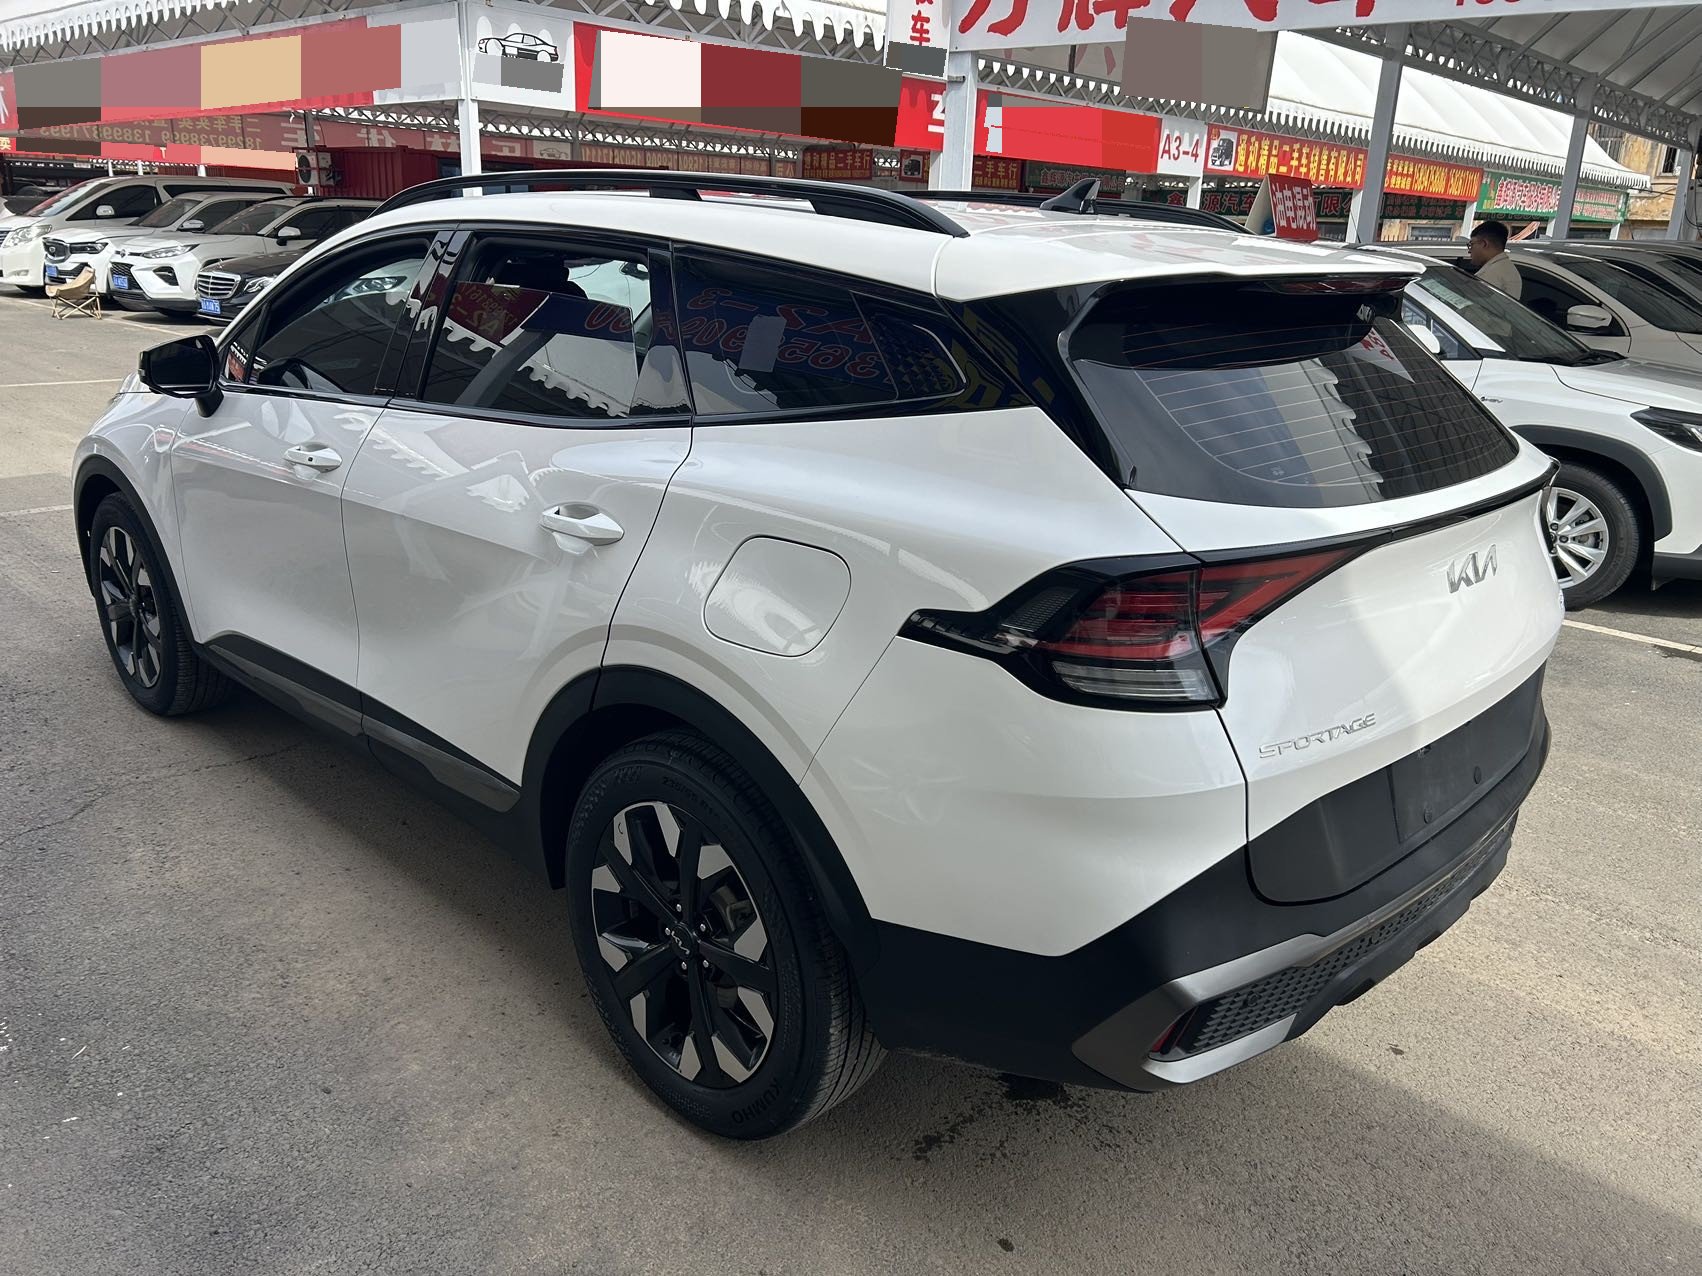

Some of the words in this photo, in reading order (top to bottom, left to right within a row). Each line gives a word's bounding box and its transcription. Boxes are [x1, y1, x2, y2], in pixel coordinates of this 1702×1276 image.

[974, 160, 1018, 179] 二手车行
[1160, 133, 1200, 163] A3-4
[1235, 133, 1365, 187] 通和精品二手车销售有限公司
[1271, 182, 1317, 231] 油电混动
[1259, 712, 1377, 759] SPORTAGE
